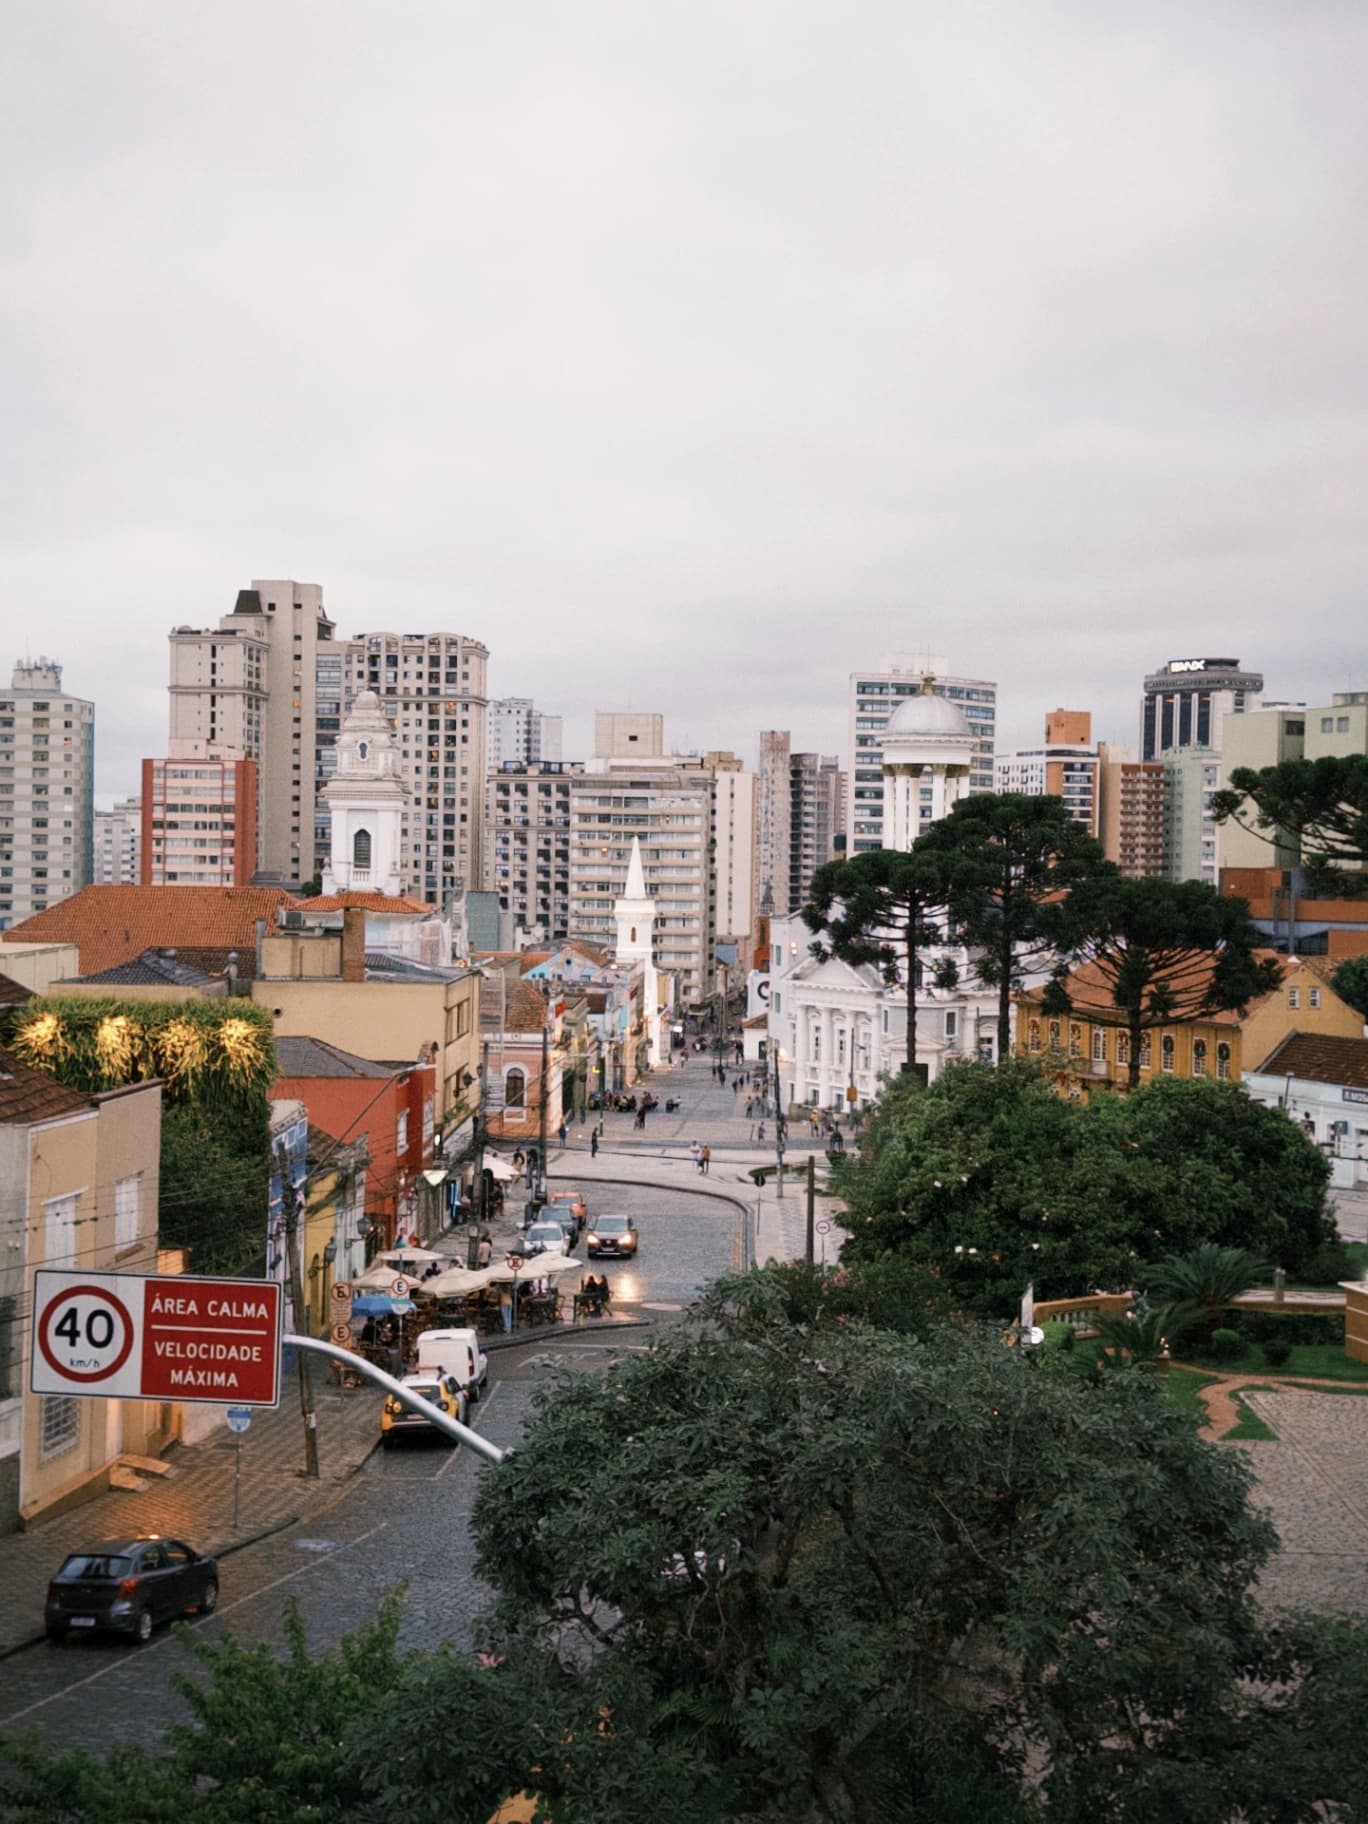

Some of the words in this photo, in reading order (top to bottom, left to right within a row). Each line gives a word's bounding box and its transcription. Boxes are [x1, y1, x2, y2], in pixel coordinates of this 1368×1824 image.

[397, 1281, 404, 1292] E
[151, 1293, 199, 1315] ÁREA
[207, 1300, 269, 1319] CALMA
[55, 1307, 114, 1349] 40
[337, 1326, 345, 1338] E
[154, 1341, 262, 1362] VELOCIDADE
[69, 1358, 100, 1368] km/h
[170, 1365, 238, 1387] MÁXIMA
